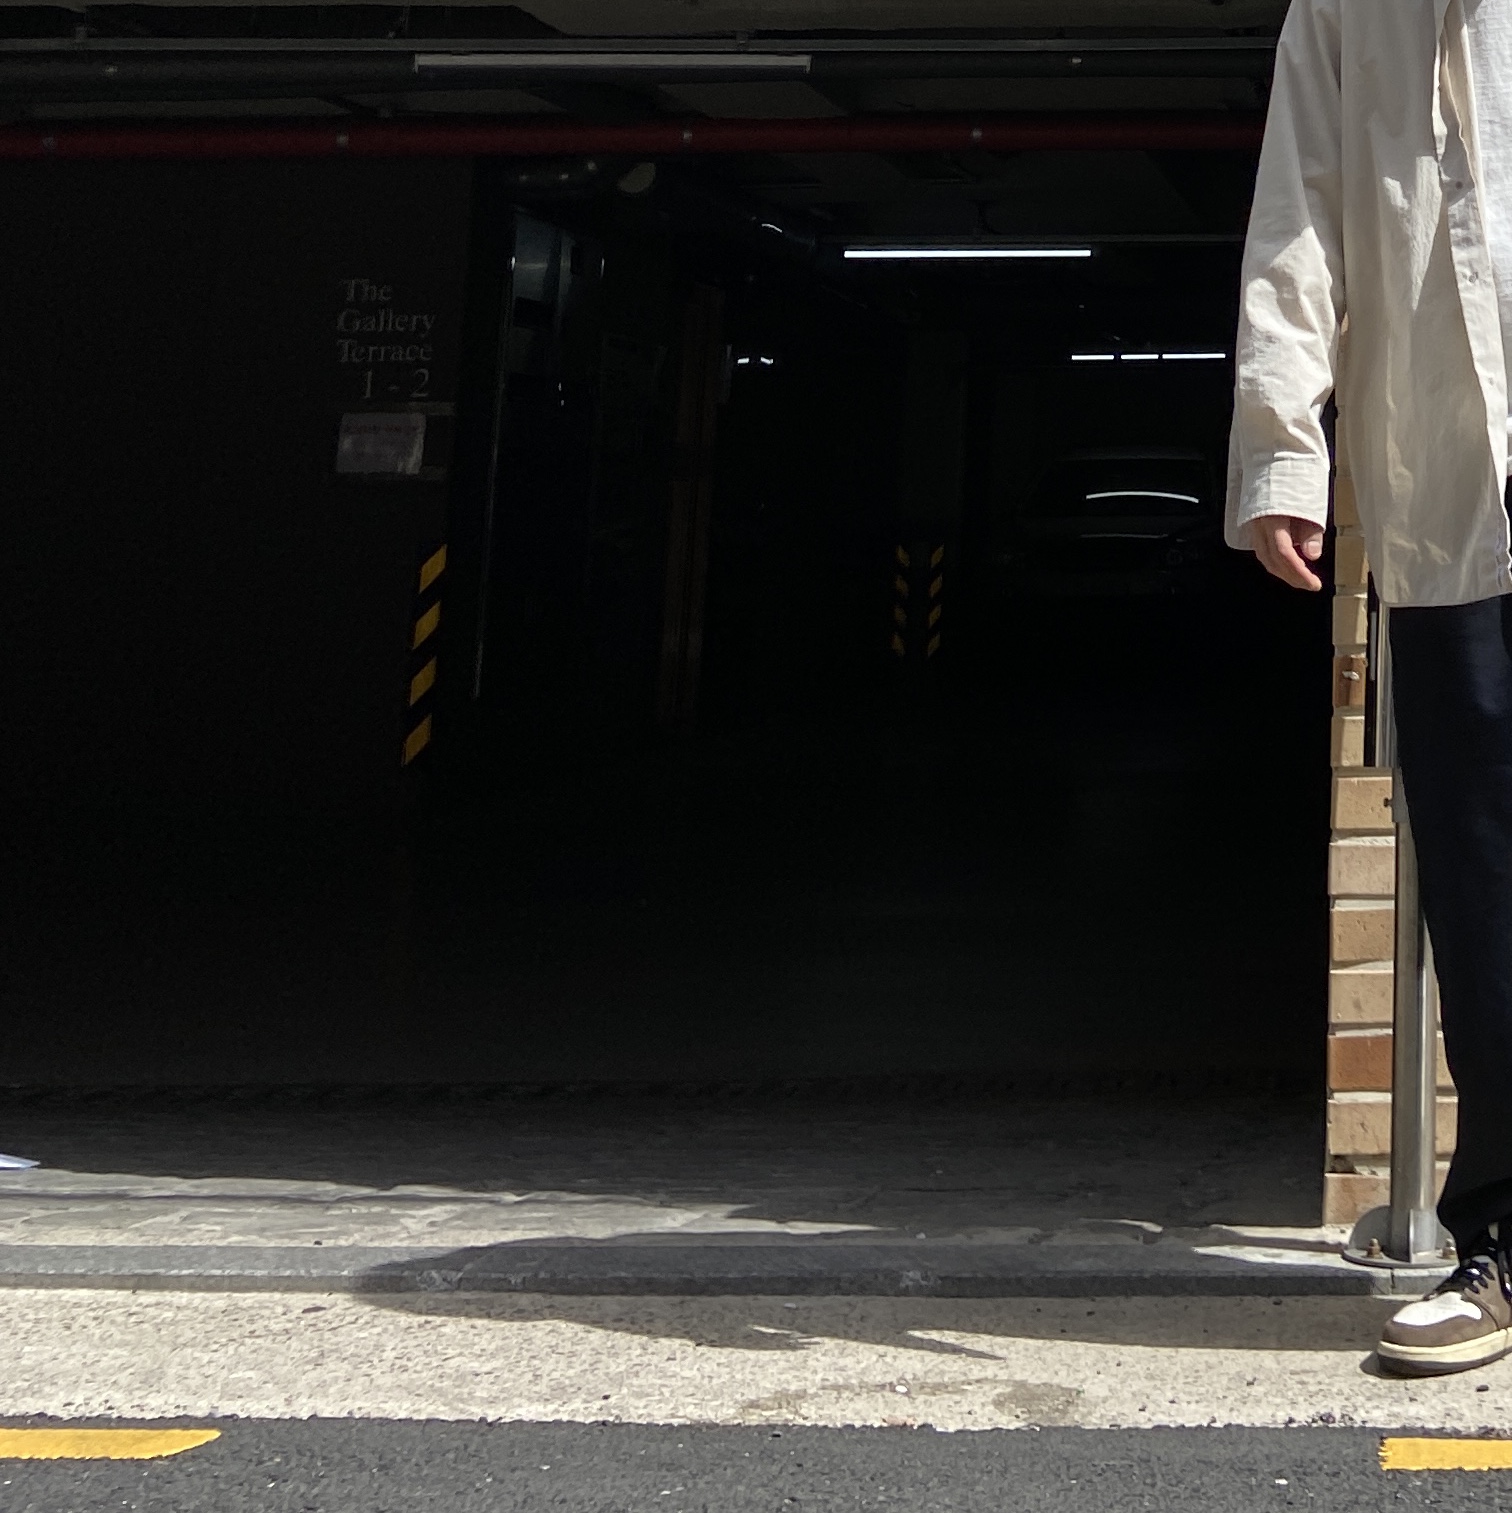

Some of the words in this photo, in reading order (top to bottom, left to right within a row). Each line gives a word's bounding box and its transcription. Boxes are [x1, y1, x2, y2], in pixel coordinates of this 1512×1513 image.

[343, 278, 392, 301] The
[337, 308, 435, 337] Gallery
[338, 339, 432, 363] Terrace
